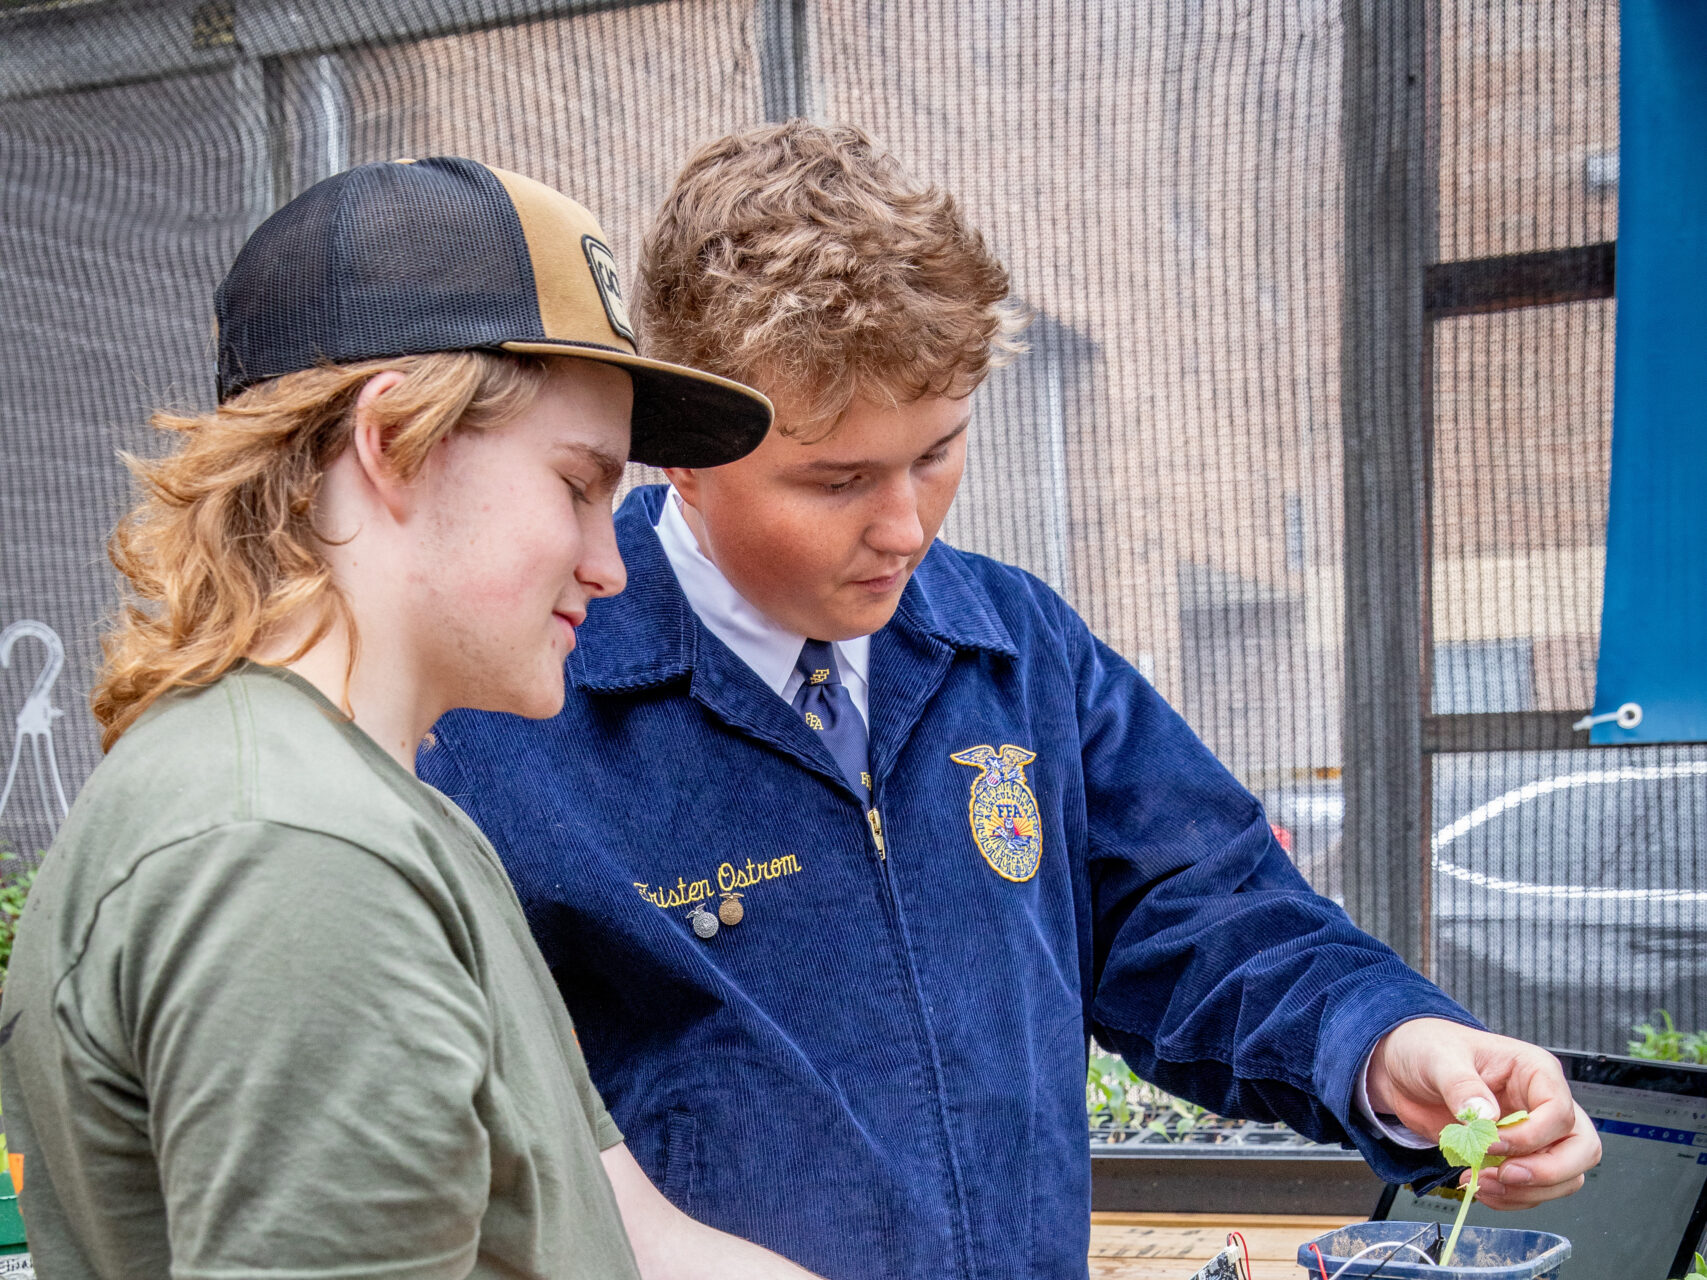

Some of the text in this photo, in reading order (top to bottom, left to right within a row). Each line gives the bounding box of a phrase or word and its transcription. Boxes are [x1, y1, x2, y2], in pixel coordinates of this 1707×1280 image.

[805, 712, 824, 730] FFA
[860, 771, 872, 791] FF
[996, 804, 1023, 818] FFA
[718, 853, 802, 892] Ostrom
